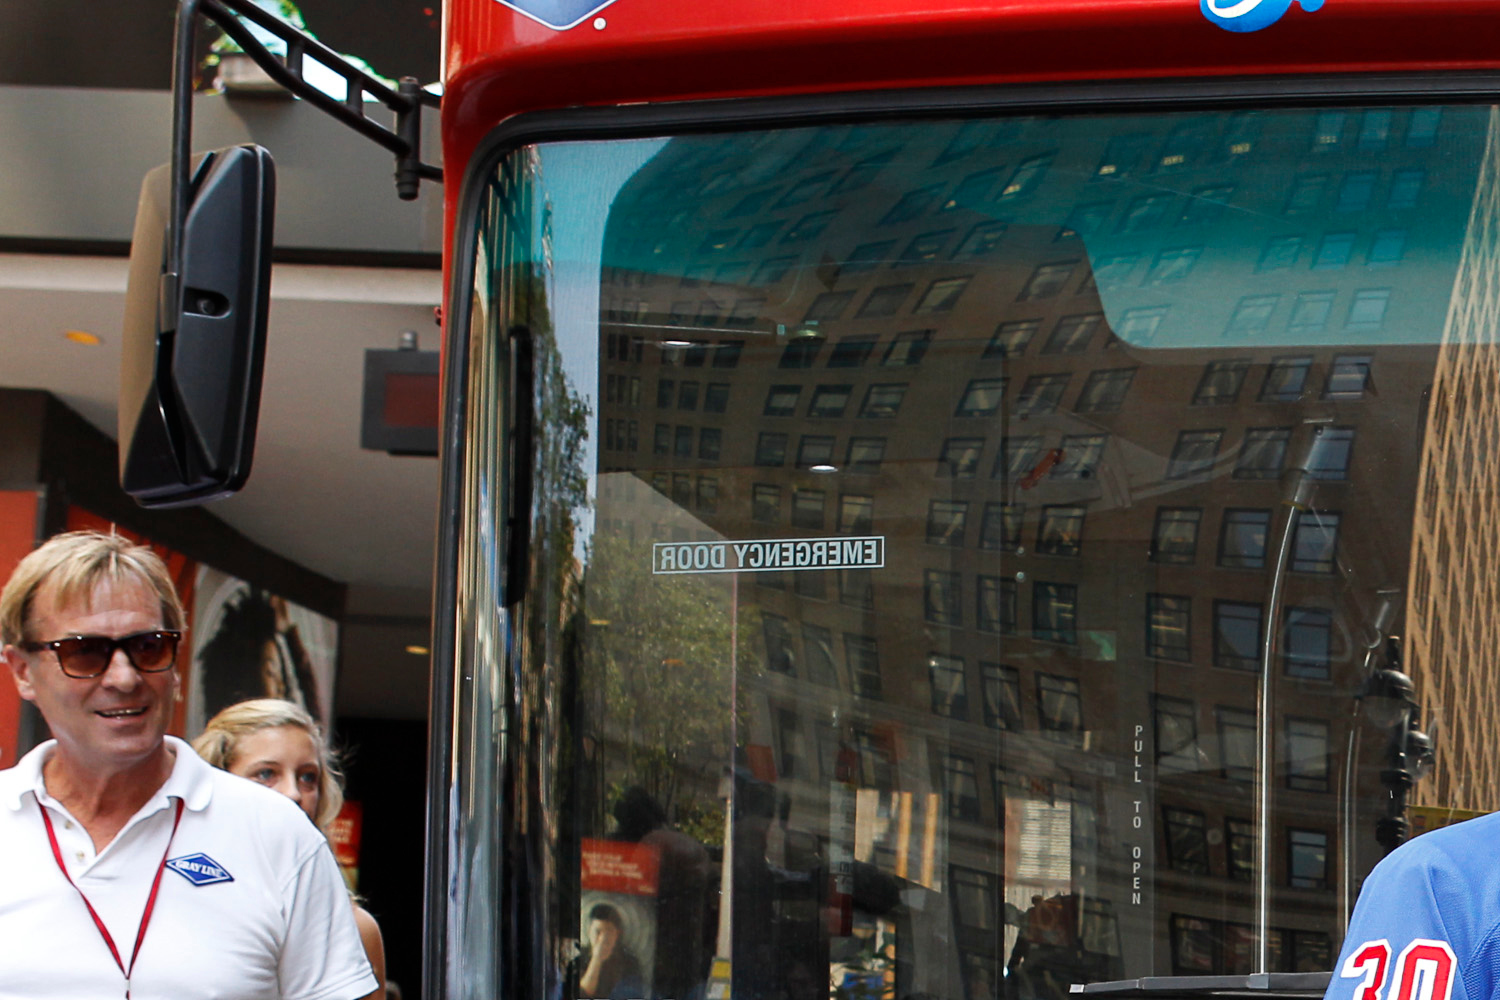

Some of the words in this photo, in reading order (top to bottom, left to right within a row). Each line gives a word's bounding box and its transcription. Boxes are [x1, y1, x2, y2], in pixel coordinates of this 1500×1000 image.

[1133, 724, 1143, 784] PULL
[1132, 800, 1142, 829] TO
[1132, 845, 1142, 905] OPEN
